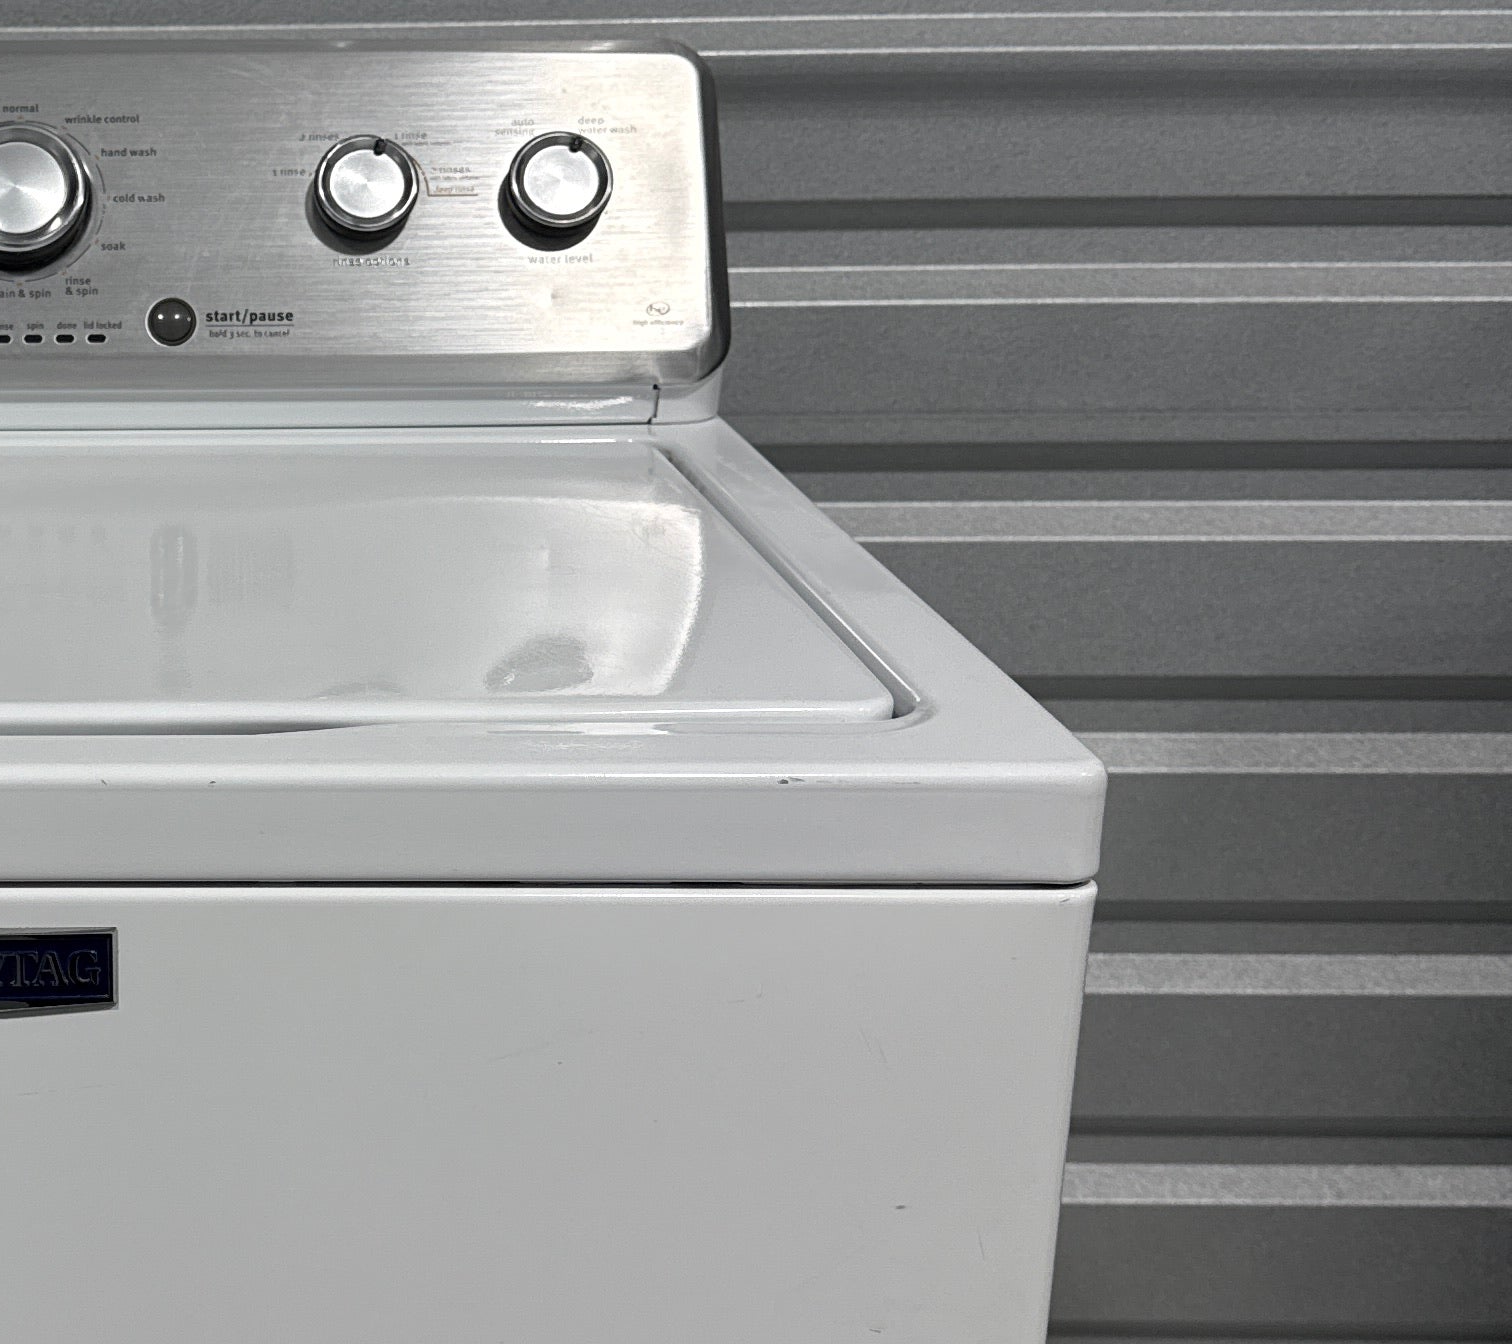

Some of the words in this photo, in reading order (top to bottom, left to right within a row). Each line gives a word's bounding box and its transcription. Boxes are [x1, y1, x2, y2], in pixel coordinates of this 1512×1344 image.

[2, 104, 38, 113] normal
[65, 114, 102, 124] wrinkle
[104, 114, 139, 124] control
[101, 148, 128, 157] hand
[130, 148, 157, 157] wash
[113, 194, 135, 203] cold
[138, 194, 165, 203] wash
[101, 242, 126, 251] soak
[65, 277, 91, 285] rinse
[18, 289, 26, 298] &
[28, 289, 51, 299] spin
[65, 286, 74, 295] &
[76, 286, 98, 297] spin
[206, 309, 294, 324] start/pause
[27, 322, 44, 332] spin
[57, 321, 77, 330] done
[84, 321, 93, 330] lid
[96, 321, 122, 330] locked
